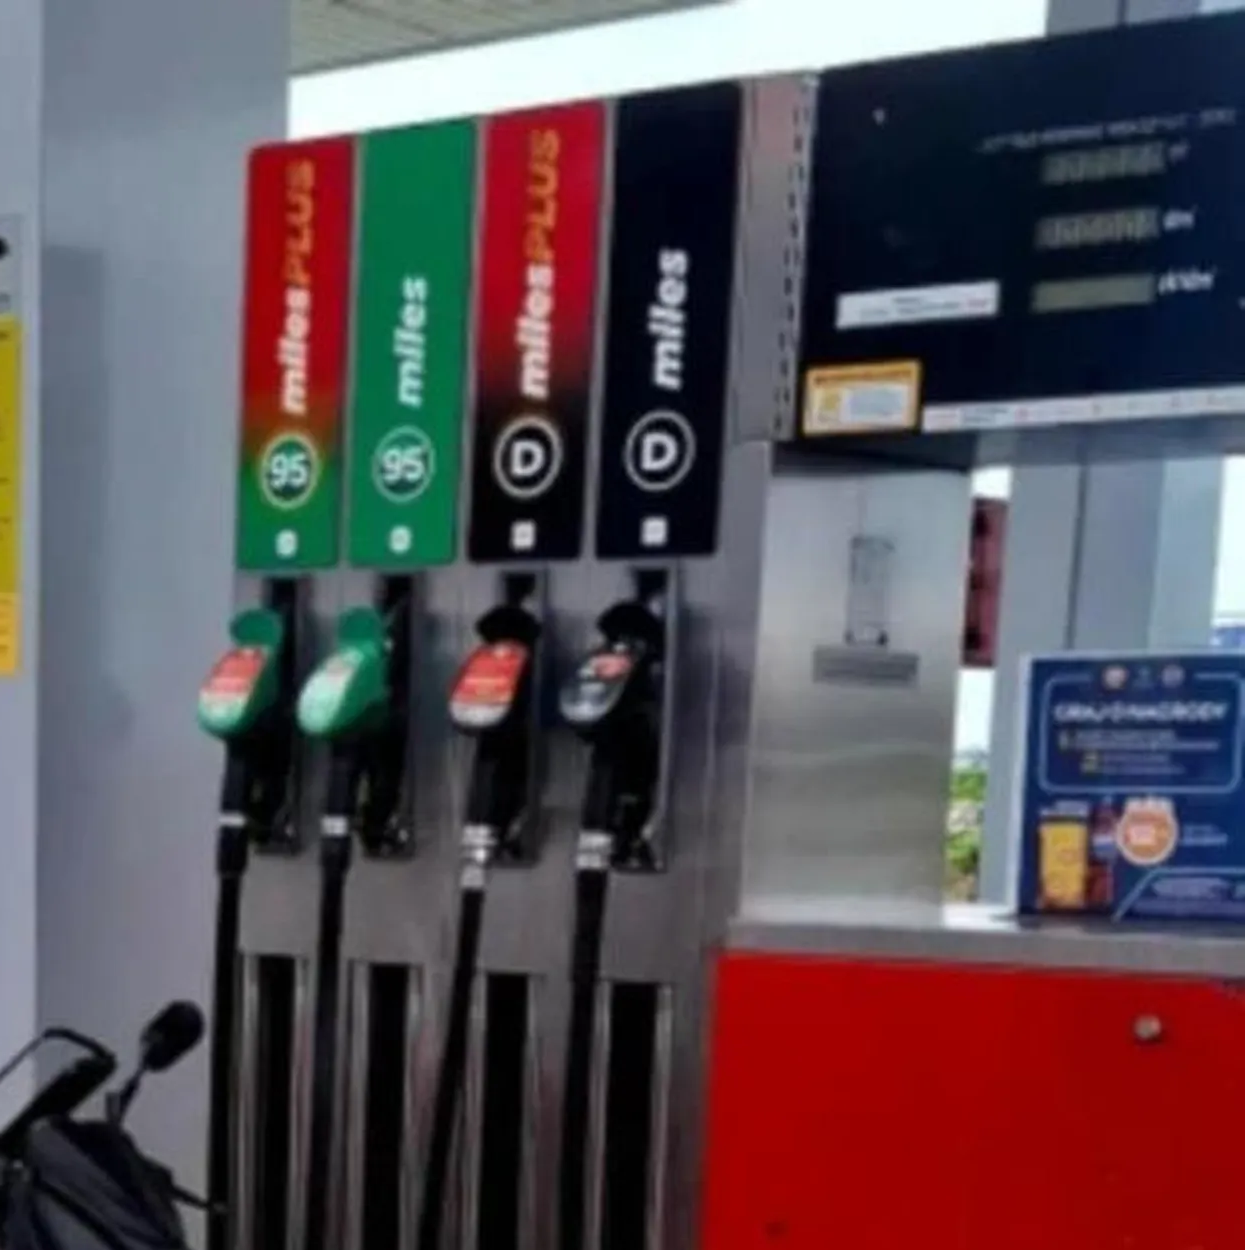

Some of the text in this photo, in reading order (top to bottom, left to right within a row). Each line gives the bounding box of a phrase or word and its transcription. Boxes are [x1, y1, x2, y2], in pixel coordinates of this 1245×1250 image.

[648, 247, 688, 391] miles
[392, 275, 428, 408] miles
[269, 451, 309, 488] 95
[380, 447, 427, 483] 95
[510, 438, 545, 477] D
[641, 431, 678, 471] D
